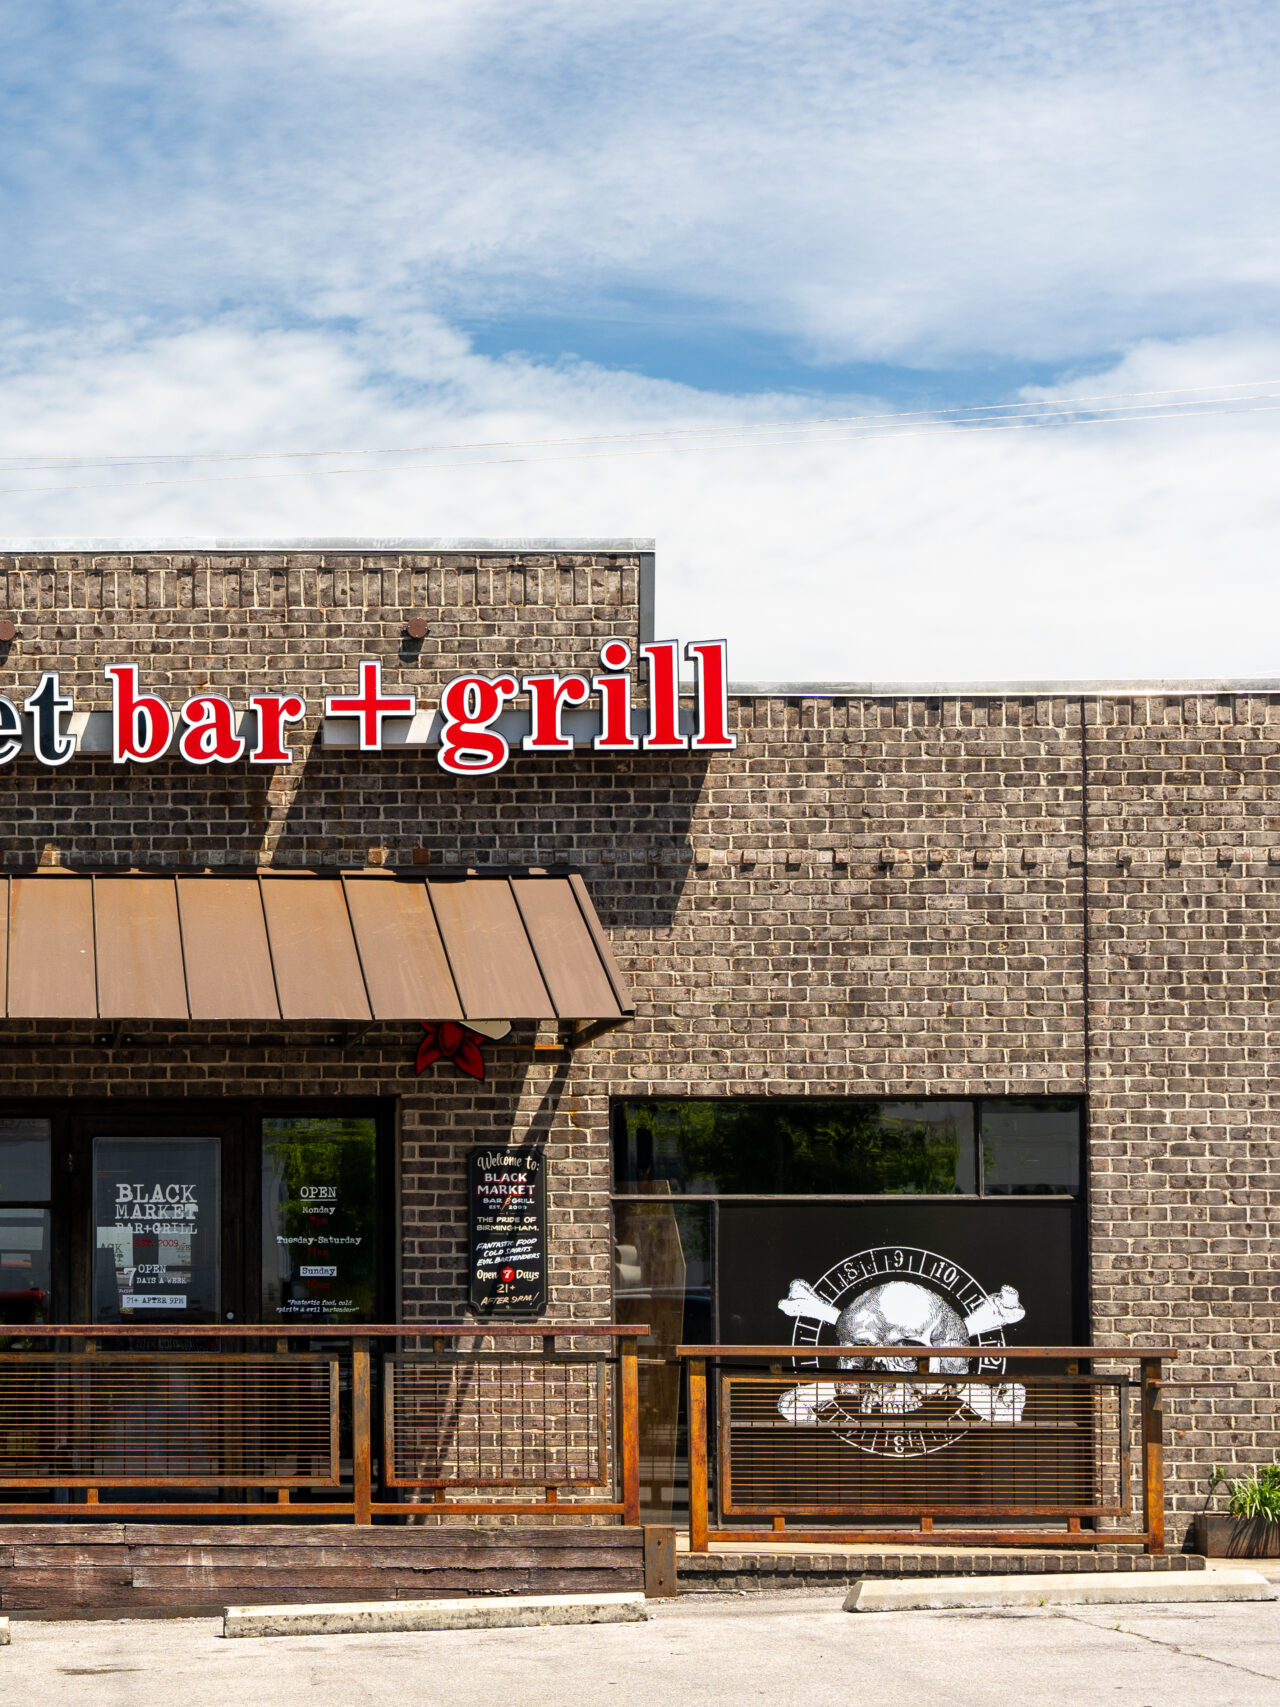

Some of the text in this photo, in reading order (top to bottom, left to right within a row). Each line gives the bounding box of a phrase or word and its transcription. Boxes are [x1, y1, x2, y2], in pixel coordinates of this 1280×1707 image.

[104, 661, 306, 765] bar
[437, 638, 738, 776] grill
[477, 1151, 539, 1171] Welcome to:
[484, 1173, 527, 1183] BLACK
[115, 1184, 197, 1203] BLACK
[300, 1186, 337, 1198] OPEN
[476, 1185, 536, 1196] MARKET
[115, 1204, 198, 1219] MARKET
[302, 1206, 336, 1215] Monday
[158, 1239, 179, 1248] 2009
[276, 1236, 362, 1245] Tuesday-Saturday
[476, 1238, 538, 1250] FANTASTIC FOOD
[504, 1246, 533, 1254] SPIRITS
[477, 1252, 541, 1266] EVIL BARTENDERS
[138, 1264, 167, 1273] OPEN
[302, 1267, 335, 1276] Sunday
[894, 1250, 904, 1267] 9
[934, 1261, 957, 1283] 10
[123, 1268, 137, 1286] 7
[477, 1269, 540, 1282] Open 7 Days
[496, 1283, 516, 1293] 21+
[480, 1292, 540, 1306] AFTER 9PM!
